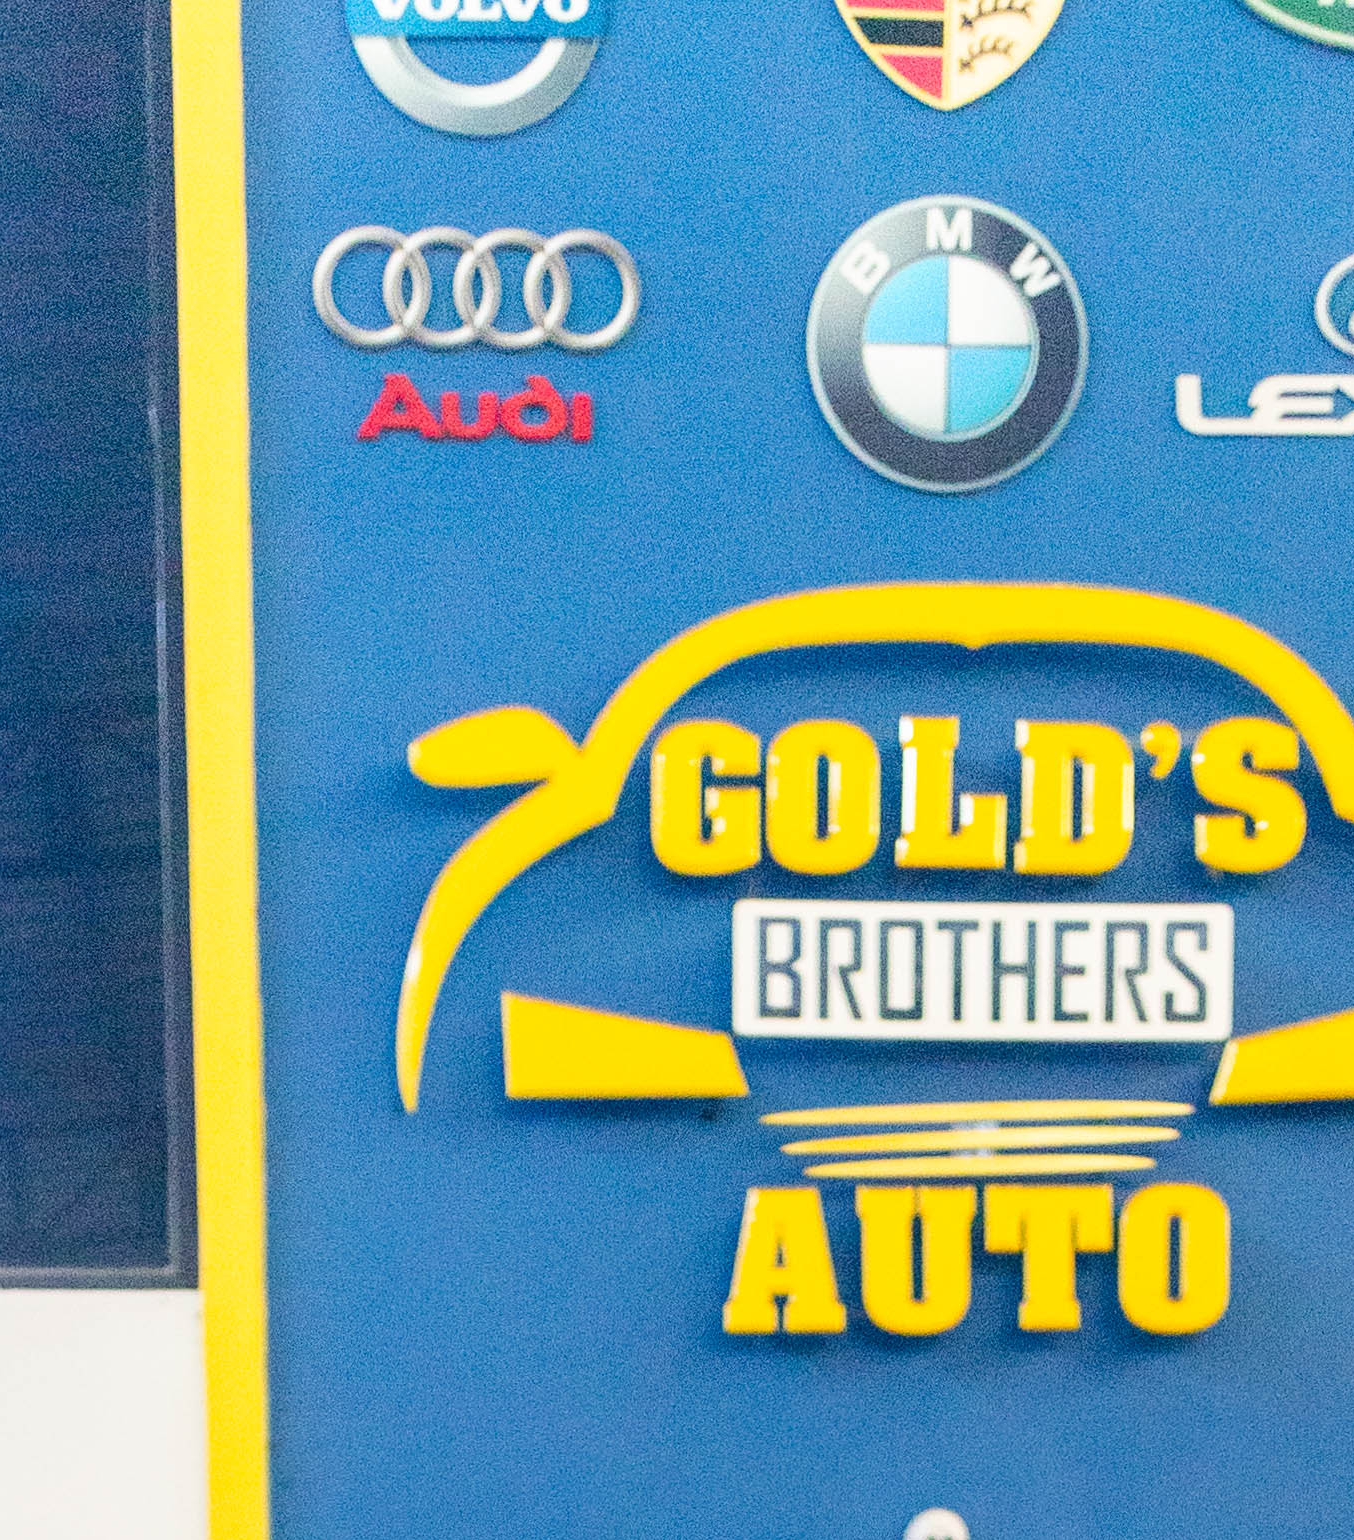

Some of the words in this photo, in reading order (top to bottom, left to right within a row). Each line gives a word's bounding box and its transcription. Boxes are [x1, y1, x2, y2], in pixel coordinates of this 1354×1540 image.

[838, 207, 1062, 298] BMW
[356, 372, 593, 442] Audi
[649, 716, 1309, 877] GOLD'S
[759, 917, 1210, 1024] BROTHERS
[722, 1182, 1232, 1337] AUTO
